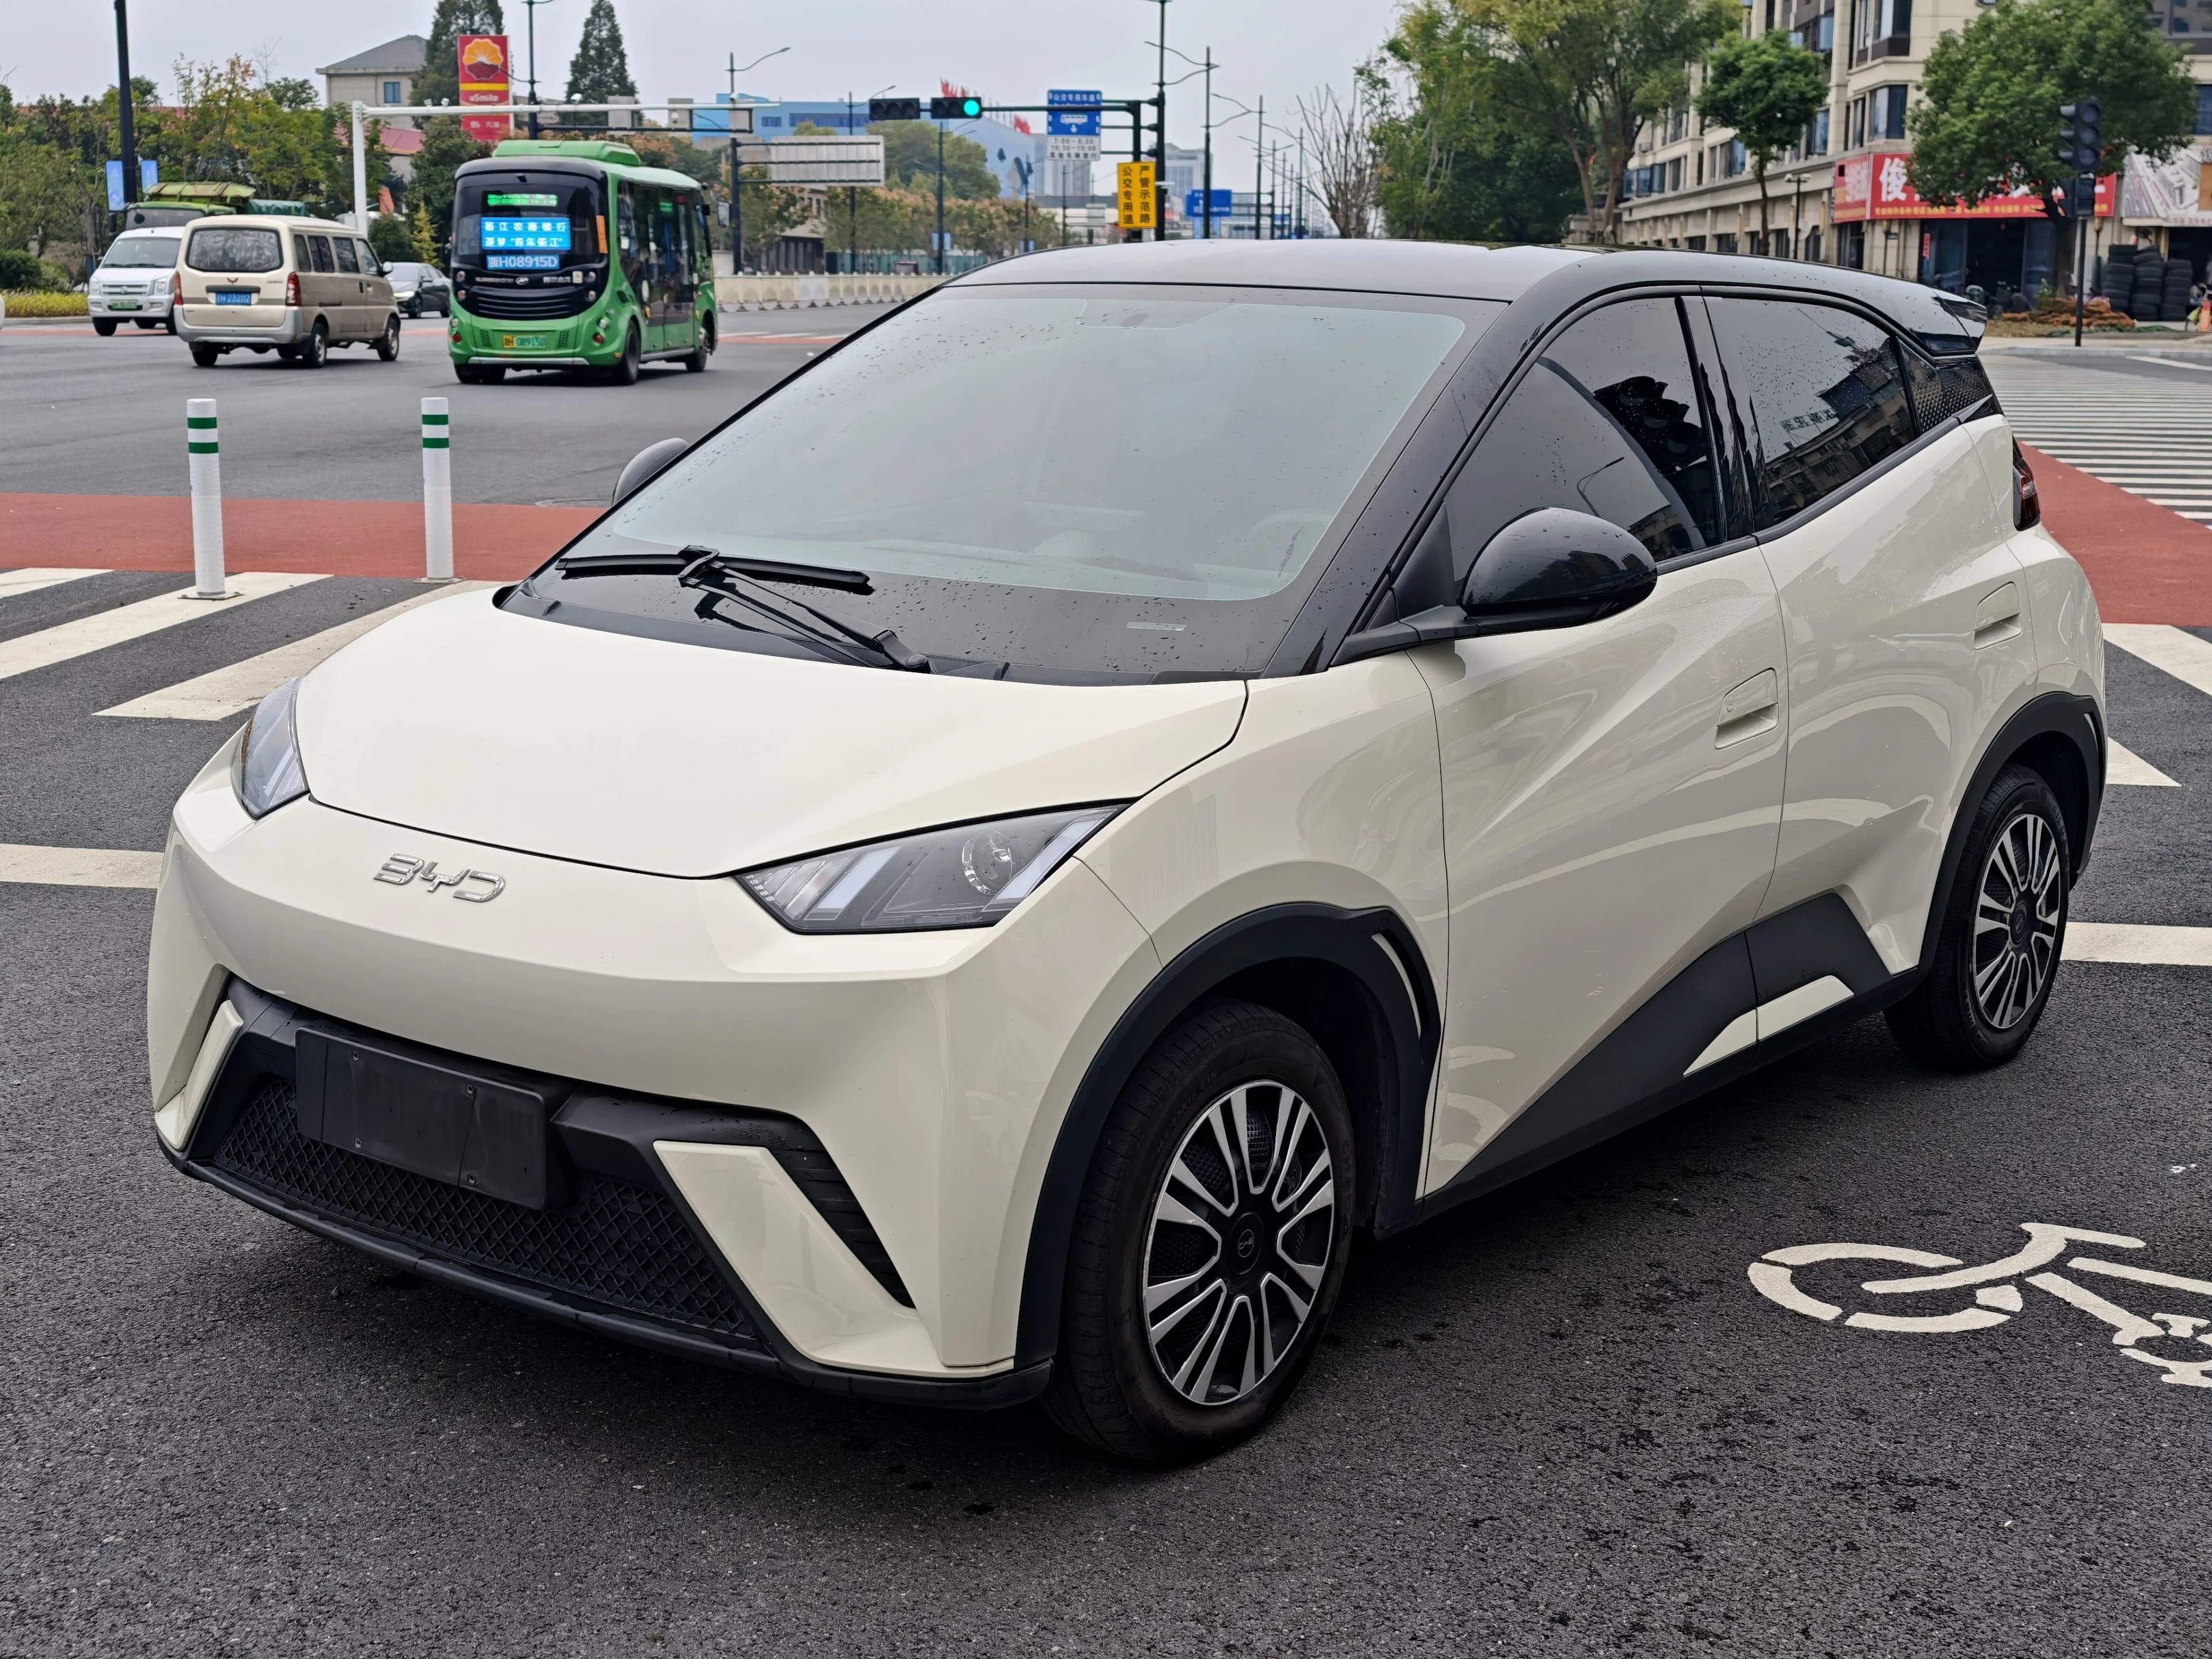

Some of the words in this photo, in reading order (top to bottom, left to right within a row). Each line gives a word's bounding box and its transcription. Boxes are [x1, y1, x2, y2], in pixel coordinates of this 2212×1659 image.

[1122, 165, 1134, 225] 公交专用道
[1139, 165, 1151, 224] 严管示范路
[487, 256, 558, 268] 浙H08915D
[372, 852, 506, 903] BYD
